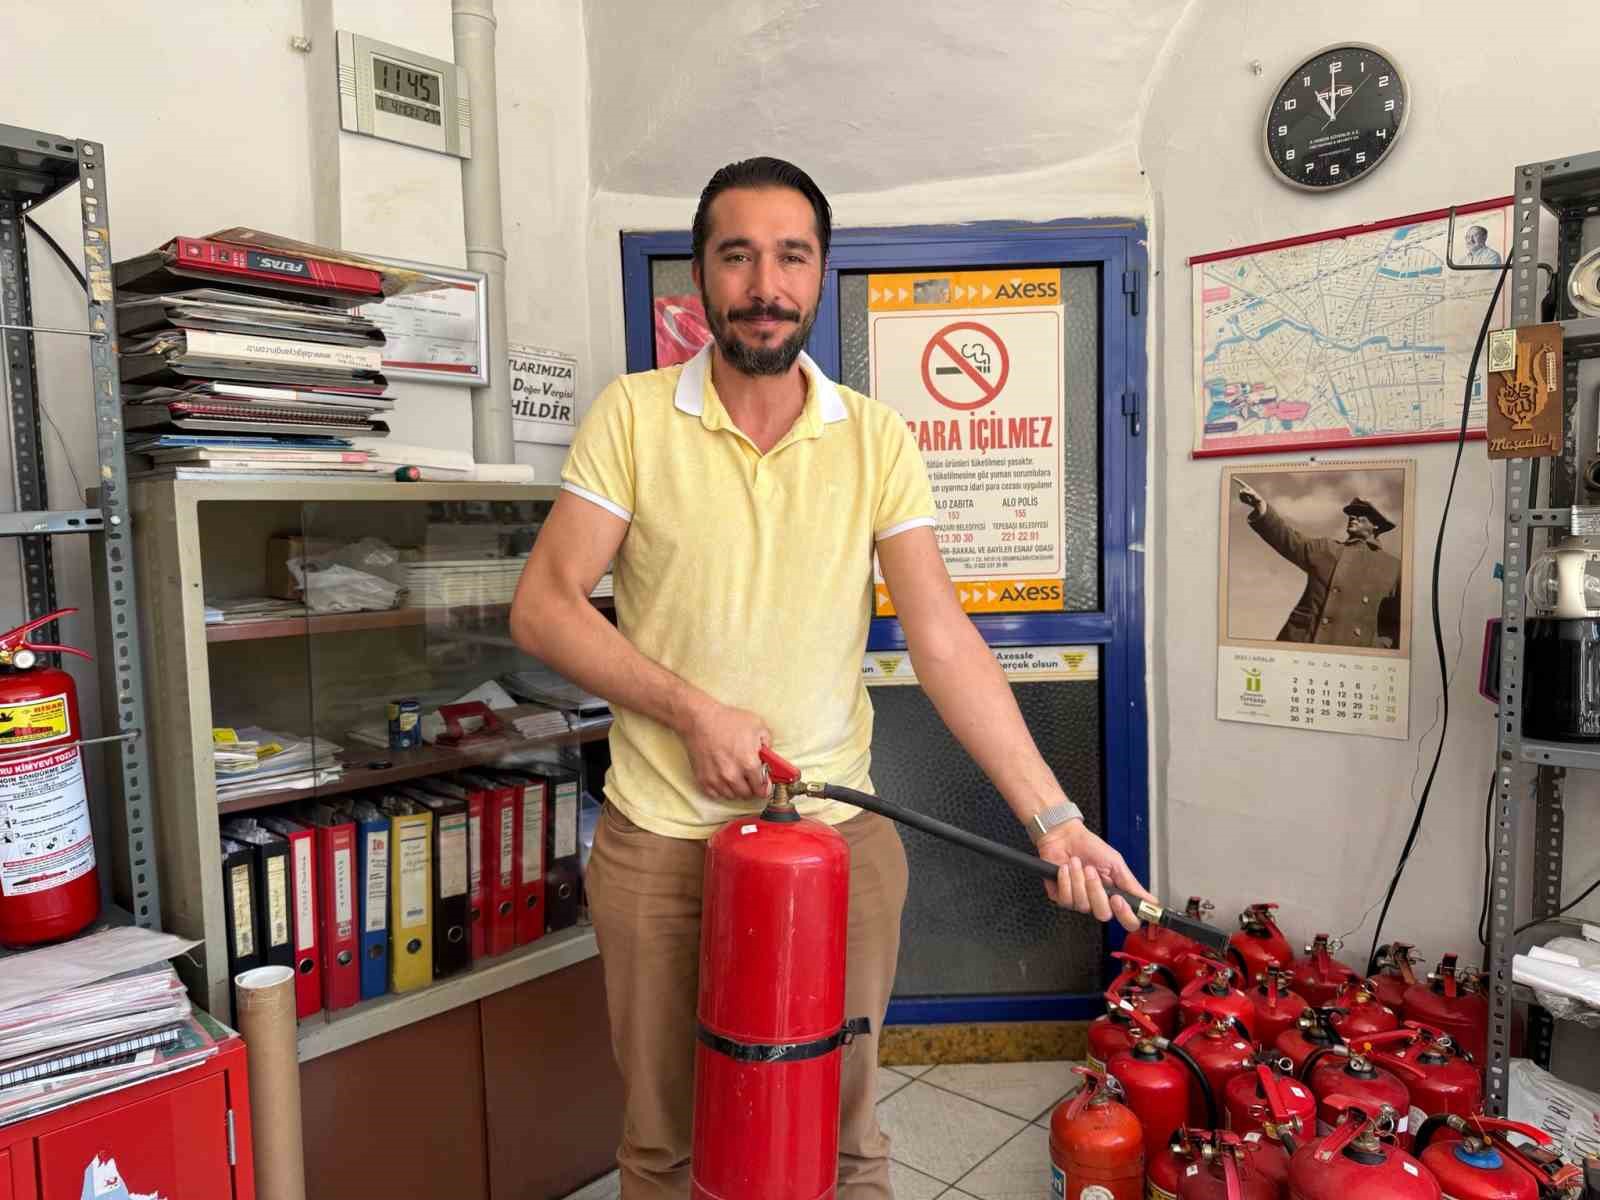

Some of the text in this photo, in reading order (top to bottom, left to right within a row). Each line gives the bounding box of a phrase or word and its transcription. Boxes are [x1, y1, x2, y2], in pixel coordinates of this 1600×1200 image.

[1360, 62, 1364, 72] 1
[1304, 77, 1310, 86] 11
[1379, 76, 1389, 87] 2
[1284, 99, 1297, 111] 10
[1385, 100, 1394, 111] 3
[1278, 126, 1287, 136] 9
[1376, 129, 1386, 139] 4
[1286, 150, 1295, 160] 8
[1356, 152, 1366, 163] 5
[1305, 163, 1314, 174] 7
[1330, 165, 1340, 175] 6
[508, 360, 571, 379] TLARIMIZA
[512, 396, 570, 421] HİLDİR
[969, 411, 1053, 454] İÇİLMEZ
[977, 471, 989, 481] göz
[990, 471, 1012, 480] yuman
[985, 483, 999, 492] para
[949, 499, 974, 509] ZABITA
[1002, 498, 1016, 507] ALO
[978, 546, 985, 554] VE
[1032, 660, 1059, 669] olsun
[1354, 692, 1362, 700] 13
[15, 757, 53, 772] KİMYEVİ
